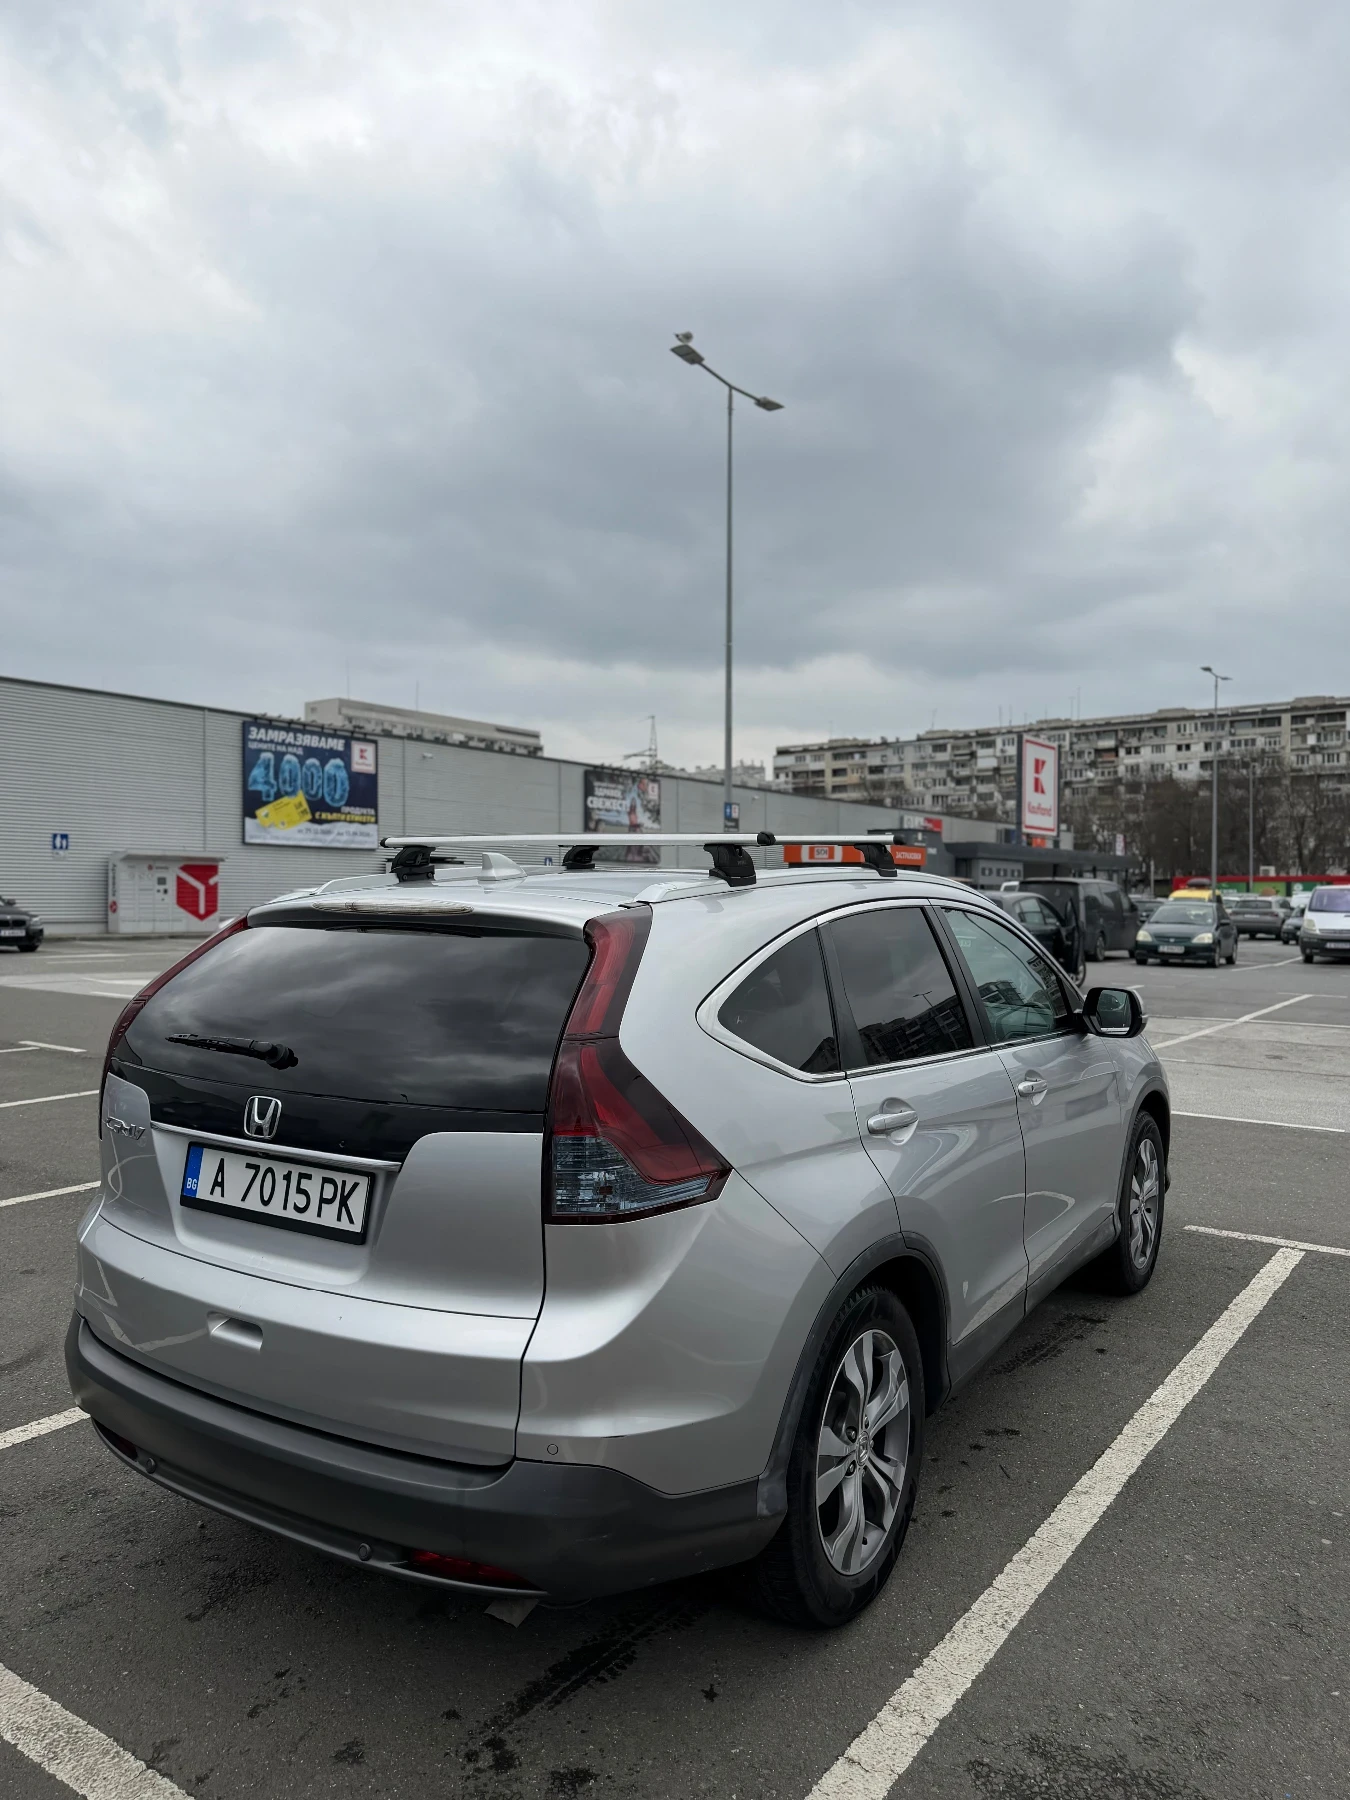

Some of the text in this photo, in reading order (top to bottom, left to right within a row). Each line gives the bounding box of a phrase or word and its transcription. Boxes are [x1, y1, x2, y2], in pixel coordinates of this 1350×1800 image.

[248, 726, 346, 751] ЗАМРАЗЯВАМЕ
[248, 741, 275, 751] ЦЕНИТЕ
[248, 751, 350, 807] 4000
[1027, 801, 1052, 817] Kaufland
[186, 1177, 198, 1190] BG
[209, 1157, 225, 1198] A
